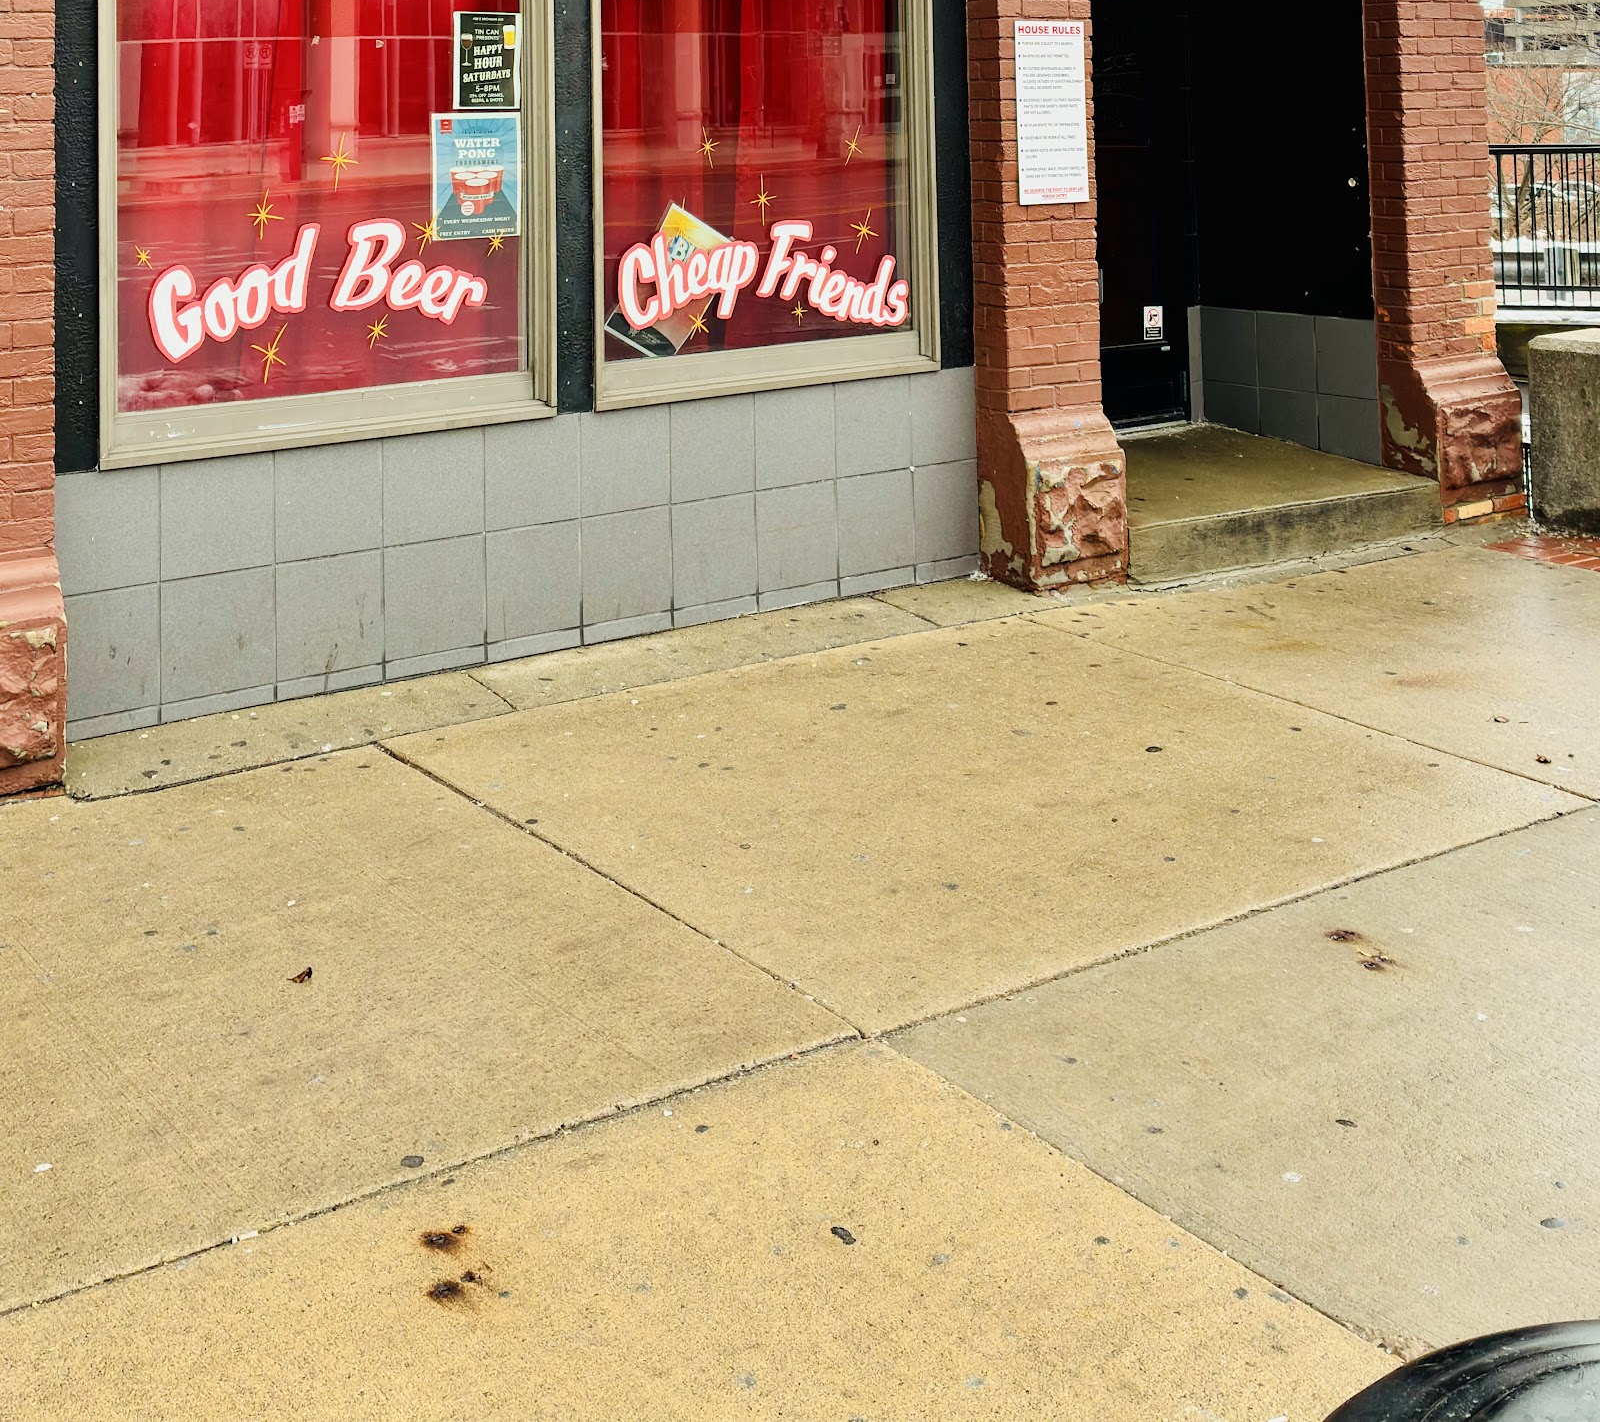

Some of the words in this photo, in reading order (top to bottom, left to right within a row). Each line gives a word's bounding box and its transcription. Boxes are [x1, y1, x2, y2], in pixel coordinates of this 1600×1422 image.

[1018, 26, 1050, 34] HOUSE
[1052, 26, 1081, 34] RULES
[474, 44, 503, 56] HAPPY
[474, 56, 503, 70] HOUR
[463, 69, 511, 83] SATURDAYS
[454, 138, 500, 148] WATER
[458, 149, 496, 159] PONG
[618, 230, 759, 331] Cheap
[756, 219, 909, 327] Friends
[148, 222, 321, 364] Good
[329, 218, 488, 325] Beer
